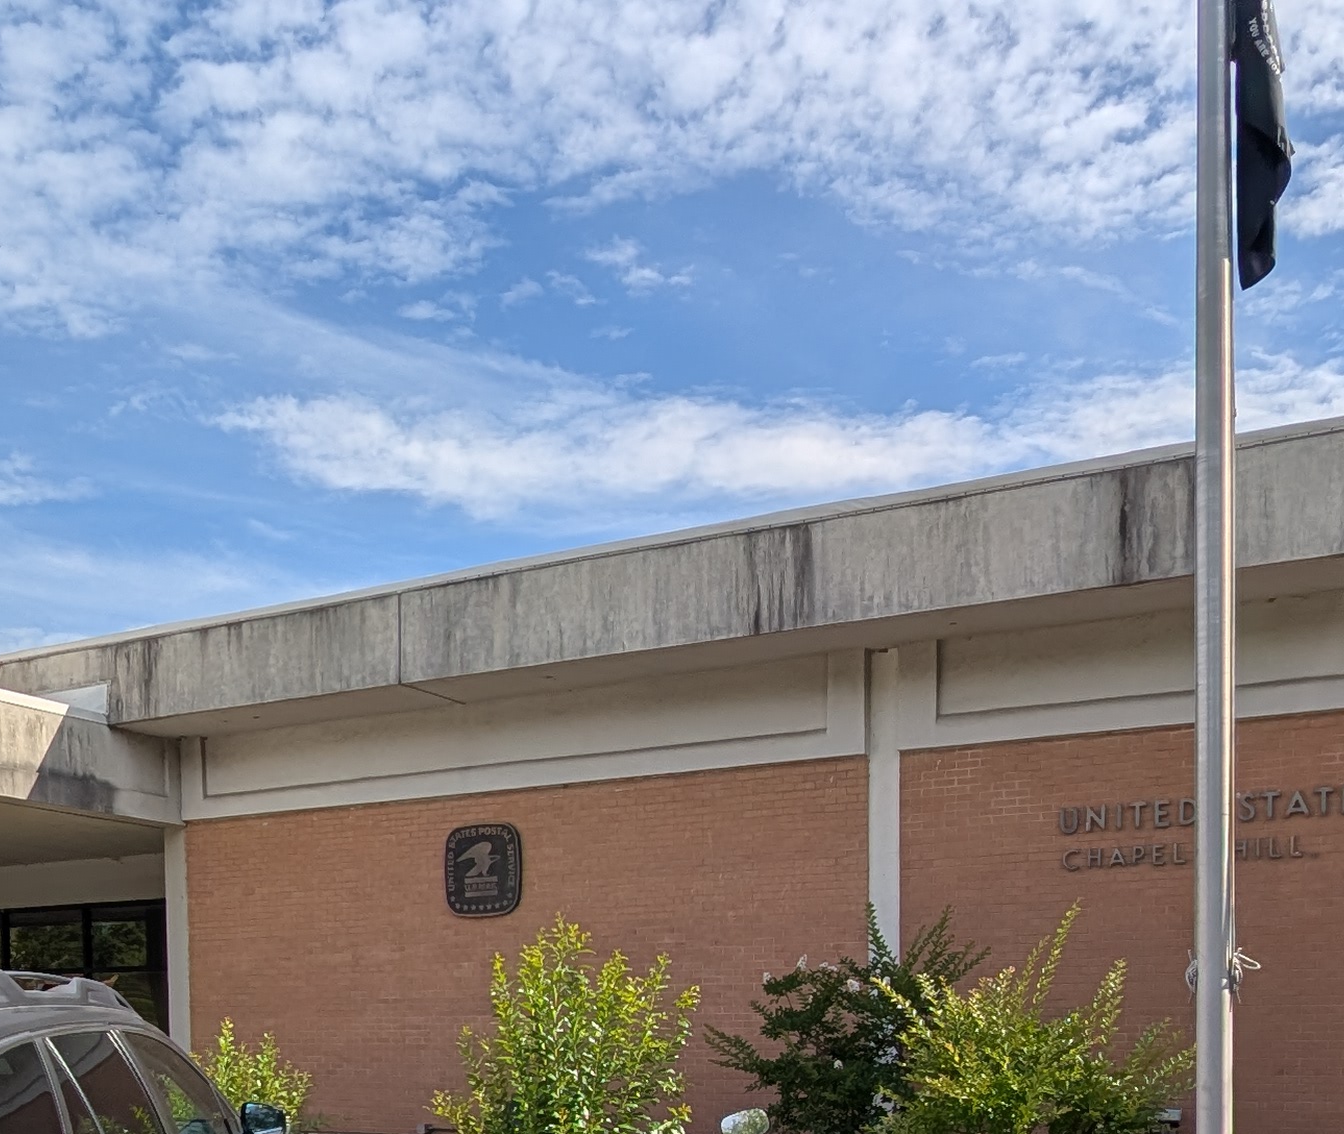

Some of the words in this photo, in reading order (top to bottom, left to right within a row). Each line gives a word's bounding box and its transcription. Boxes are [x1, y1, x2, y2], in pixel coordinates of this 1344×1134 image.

[1249, 17, 1259, 37] YOU
[1254, 40, 1269, 57] ARE
[1059, 797, 1197, 834] UNITED
[478, 827, 512, 842] POSTAL
[1062, 843, 1186, 871] CHAPEL
